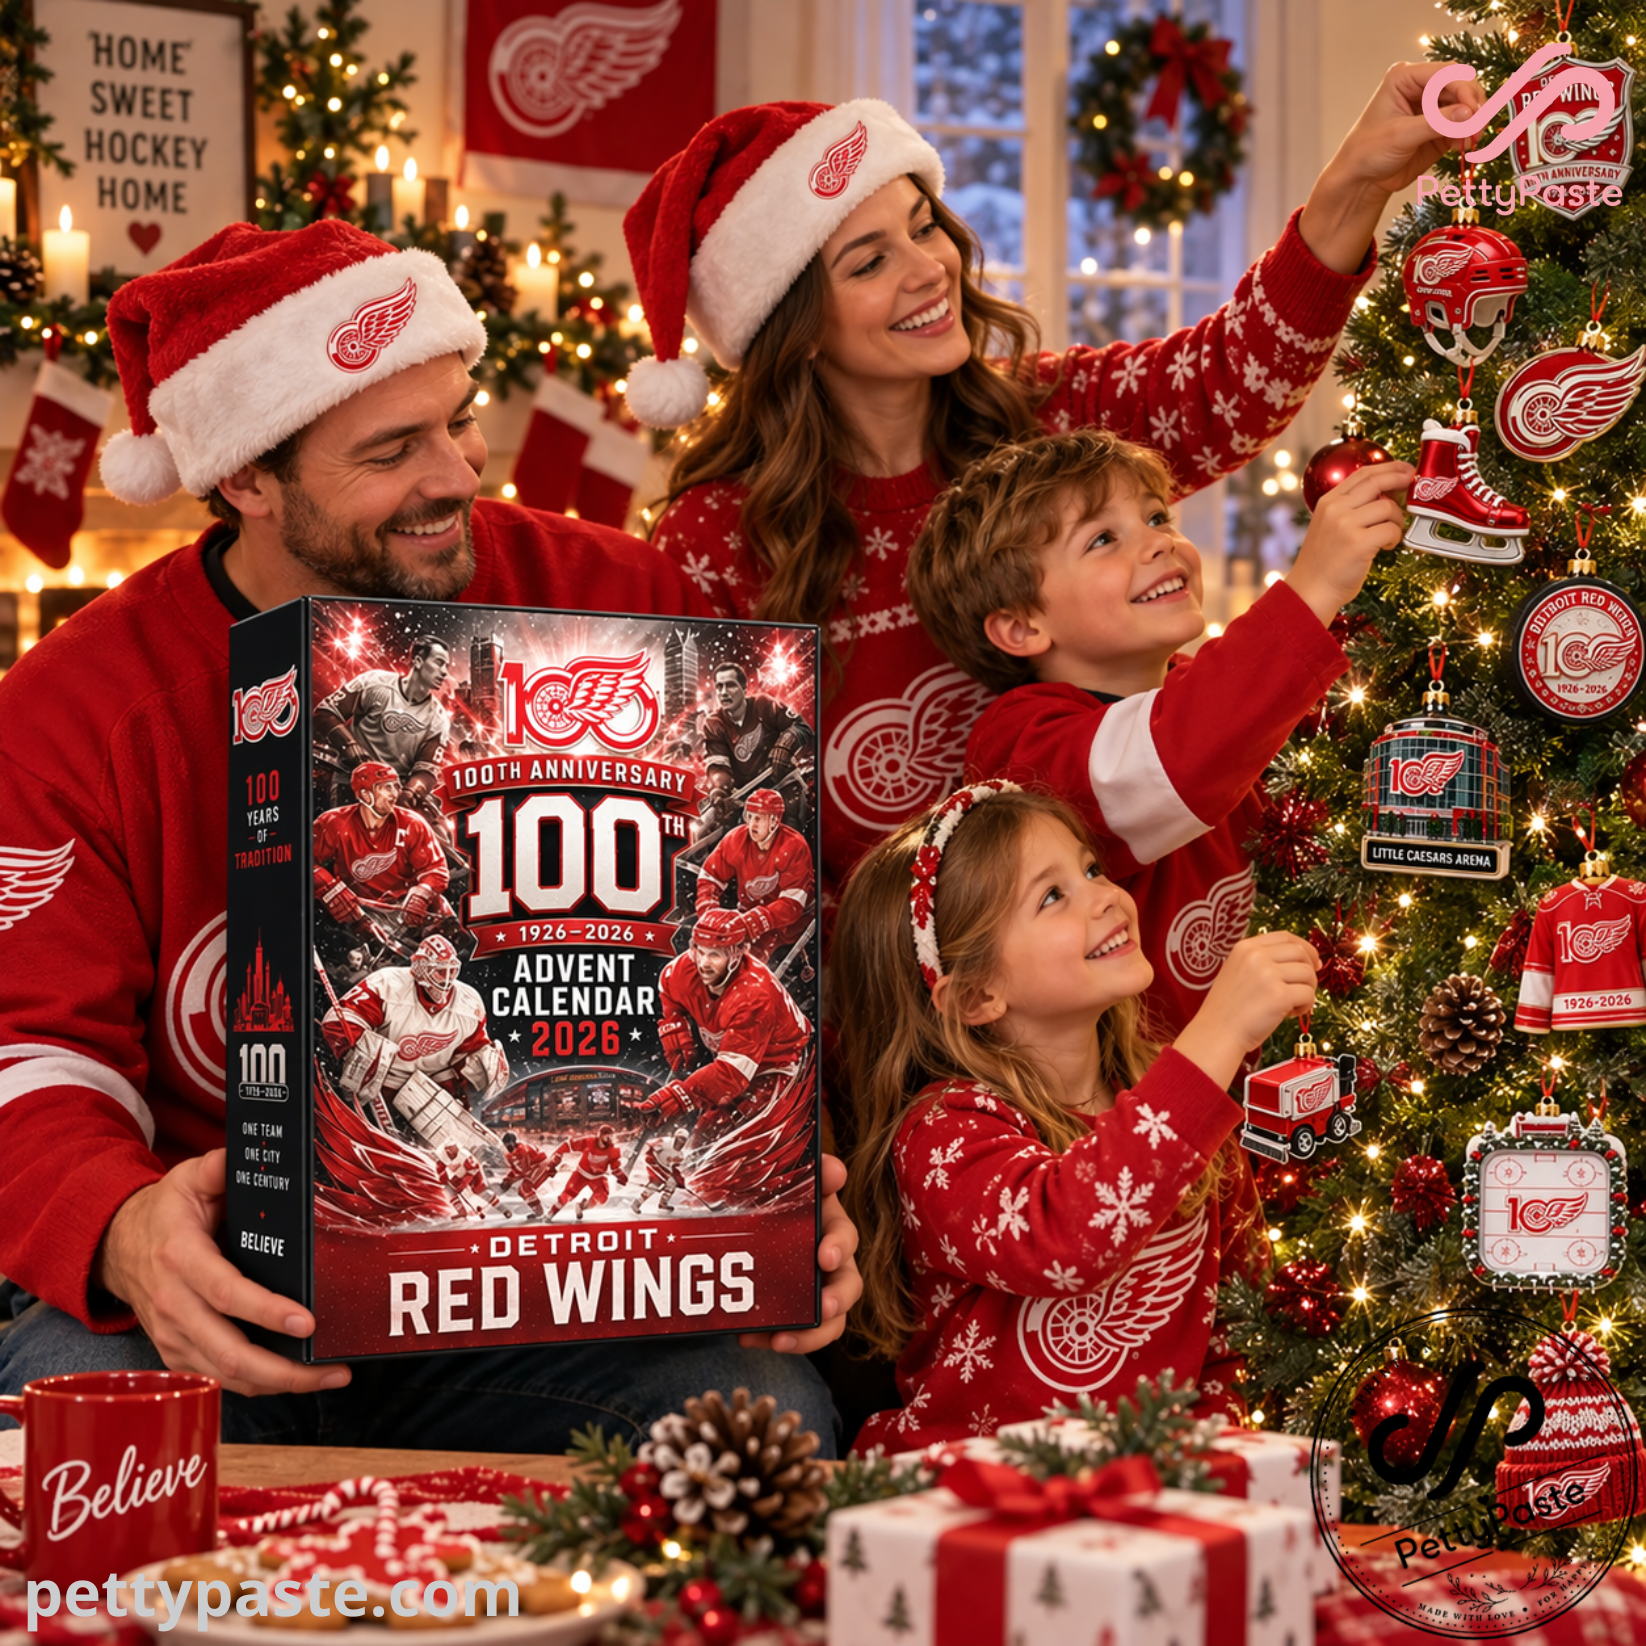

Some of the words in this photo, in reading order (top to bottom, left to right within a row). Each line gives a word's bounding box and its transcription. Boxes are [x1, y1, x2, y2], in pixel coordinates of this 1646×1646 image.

[89, 31, 192, 75] HOME
[91, 80, 193, 122] SWEET
[85, 127, 207, 170] HOCKEY
[98, 176, 187, 214] HOME
[1581, 591, 1605, 606] RED
[246, 769, 279, 806] 100
[452, 761, 521, 791] 100TH
[529, 759, 686, 793] ANNIVERSARY
[246, 805, 279, 827] YEARS
[256, 829, 268, 843] OF
[234, 843, 292, 869] TRADITION
[1372, 846, 1404, 861] LITTLE
[1406, 850, 1453, 864] CAESARS
[1455, 854, 1491, 868] ARENA
[513, 953, 635, 983] ADVENT
[492, 986, 655, 1017] CALENDAR
[1564, 994, 1632, 1010] 1926-2026
[531, 1020, 620, 1057] 2026
[239, 1043, 286, 1084] 100
[242, 1121, 258, 1136] ONE
[260, 1123, 283, 1138] TEAM
[244, 1146, 260, 1162] ONE
[262, 1149, 281, 1164] CITY
[235, 1170, 251, 1185] ONE
[253, 1173, 290, 1191] CENTURY
[240, 1230, 285, 1257] BELIEVE
[489, 1228, 658, 1259] DETROIT
[388, 1264, 520, 1337] RED
[543, 1251, 755, 1326] WINGS
[41, 1444, 208, 1542] Believe
